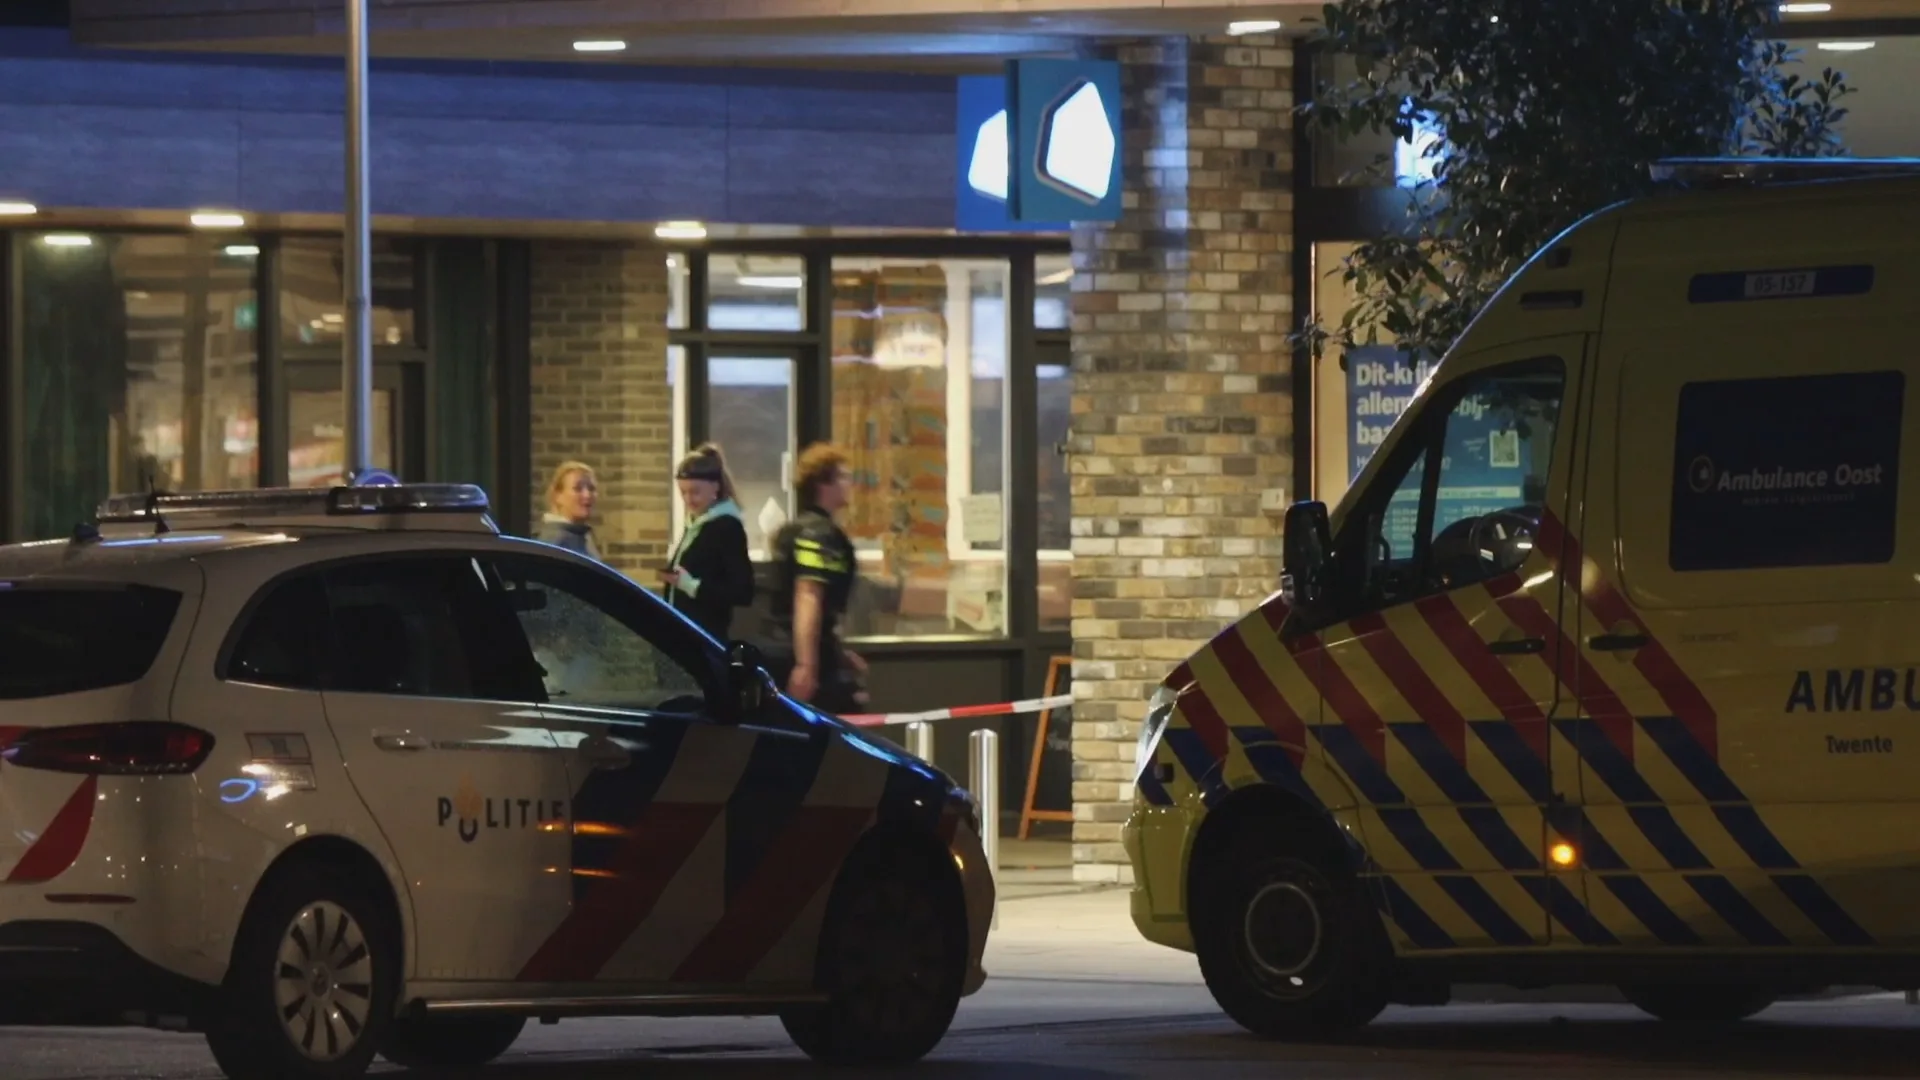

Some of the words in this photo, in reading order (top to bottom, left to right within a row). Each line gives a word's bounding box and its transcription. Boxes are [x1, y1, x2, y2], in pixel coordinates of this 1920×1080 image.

[1717, 465, 1828, 491] Ambulance
[1834, 462, 1882, 487] Oost
[1825, 735, 1893, 754] Twente
